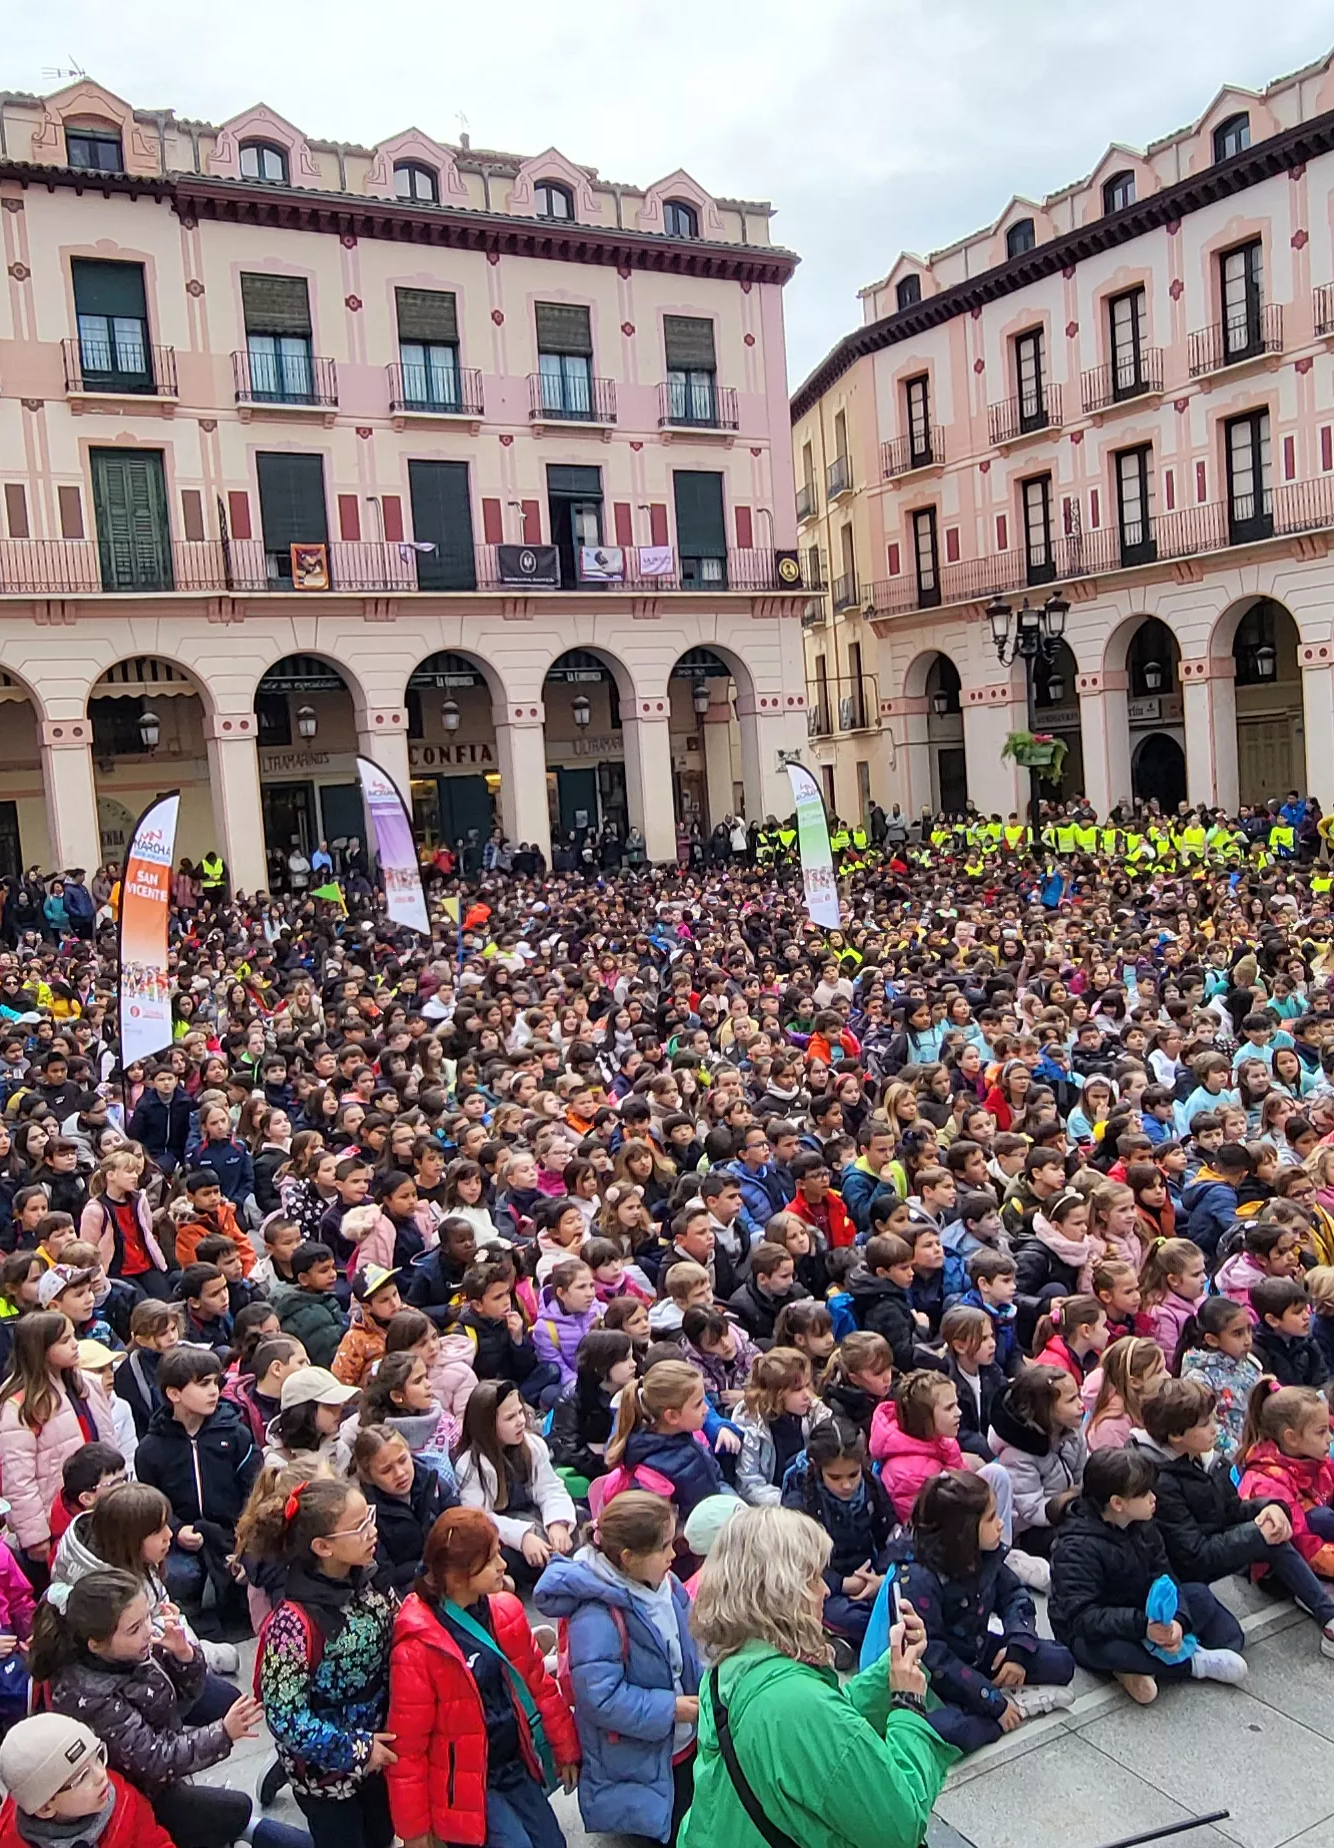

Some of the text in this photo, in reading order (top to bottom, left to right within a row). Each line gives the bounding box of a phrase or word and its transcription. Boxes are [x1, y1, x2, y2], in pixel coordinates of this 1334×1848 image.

[409, 744, 493, 766] CONFIA
[137, 870, 159, 886] SAN
[126, 881, 168, 903] VICENTE
